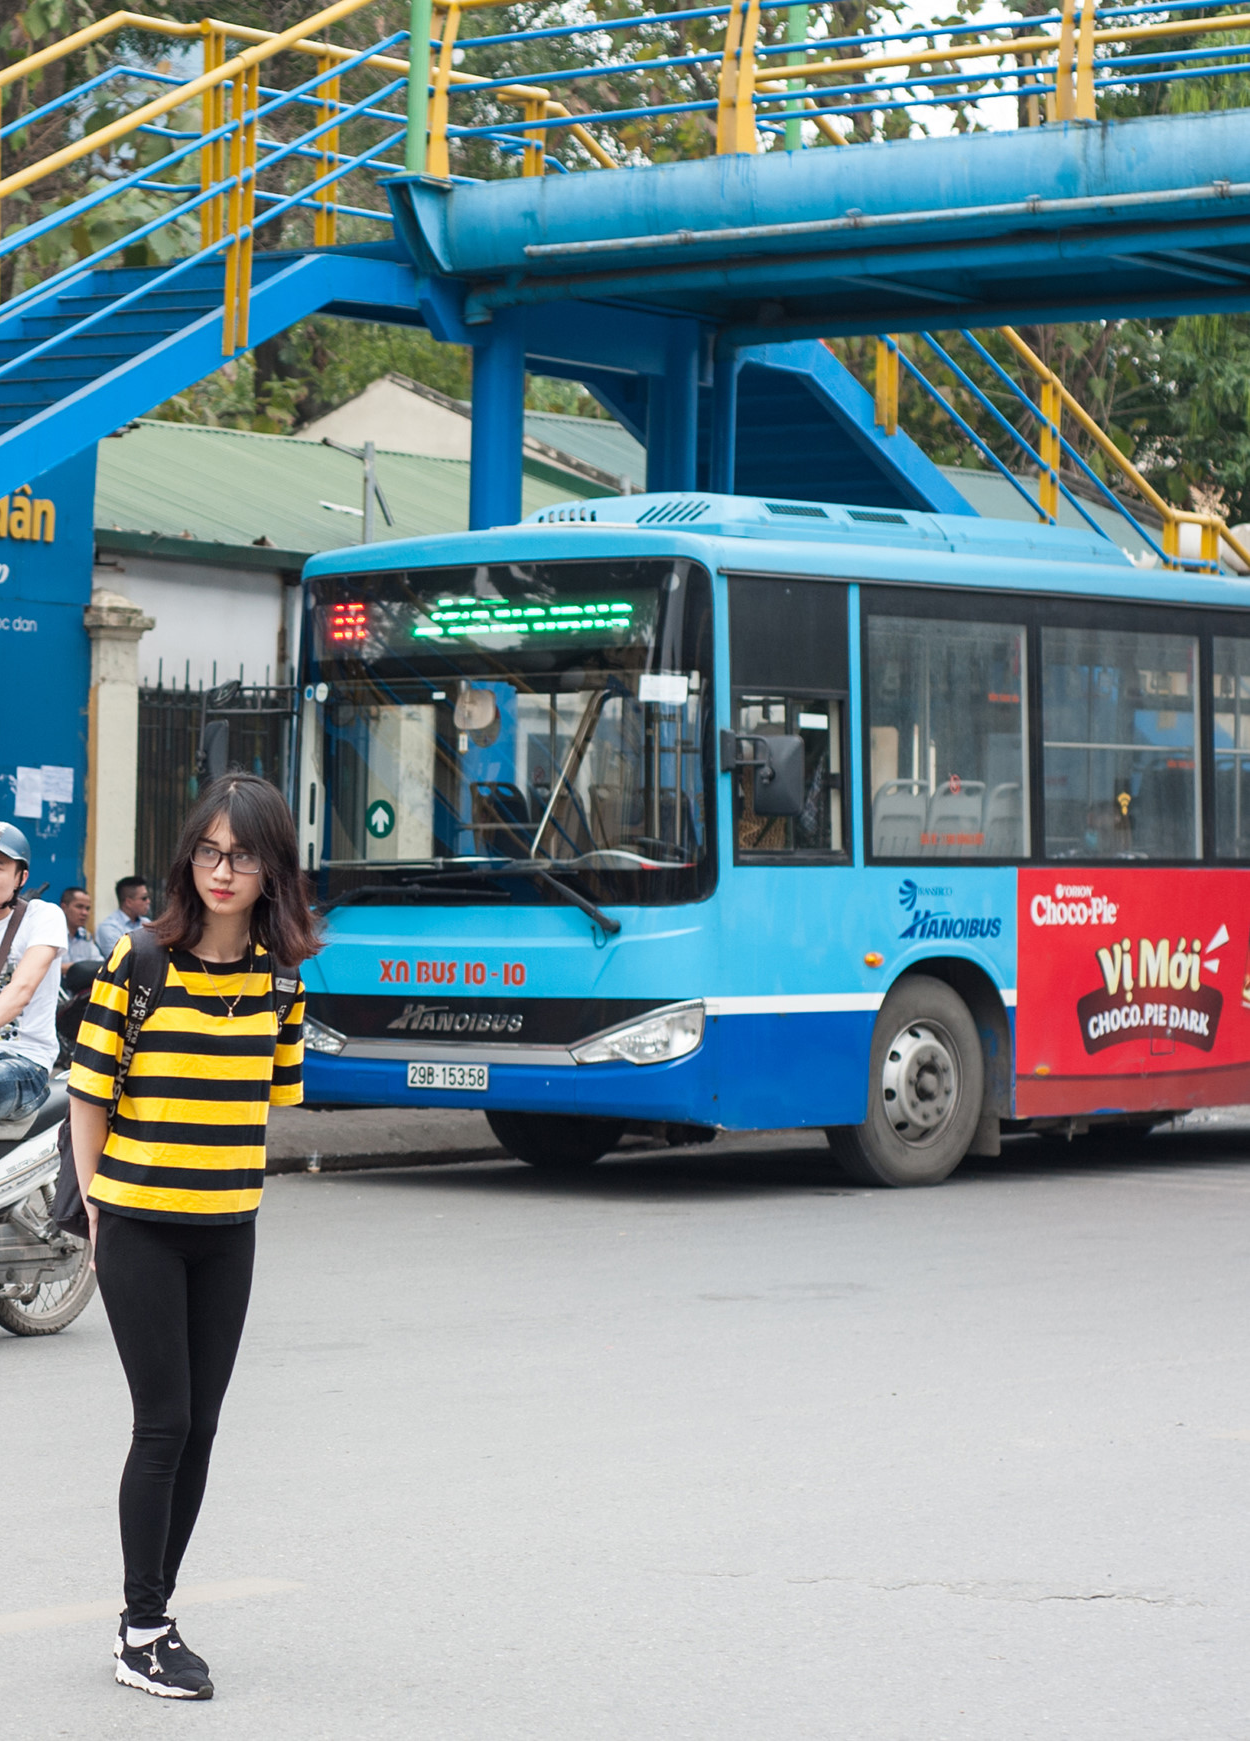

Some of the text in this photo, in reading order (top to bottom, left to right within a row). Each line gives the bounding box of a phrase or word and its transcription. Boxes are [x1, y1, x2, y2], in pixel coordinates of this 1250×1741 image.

[13, 616, 38, 633] dan
[416, 961, 458, 986] BUS
[1095, 936, 1202, 1003] Vị Mới
[1168, 1004, 1210, 1038] DARK
